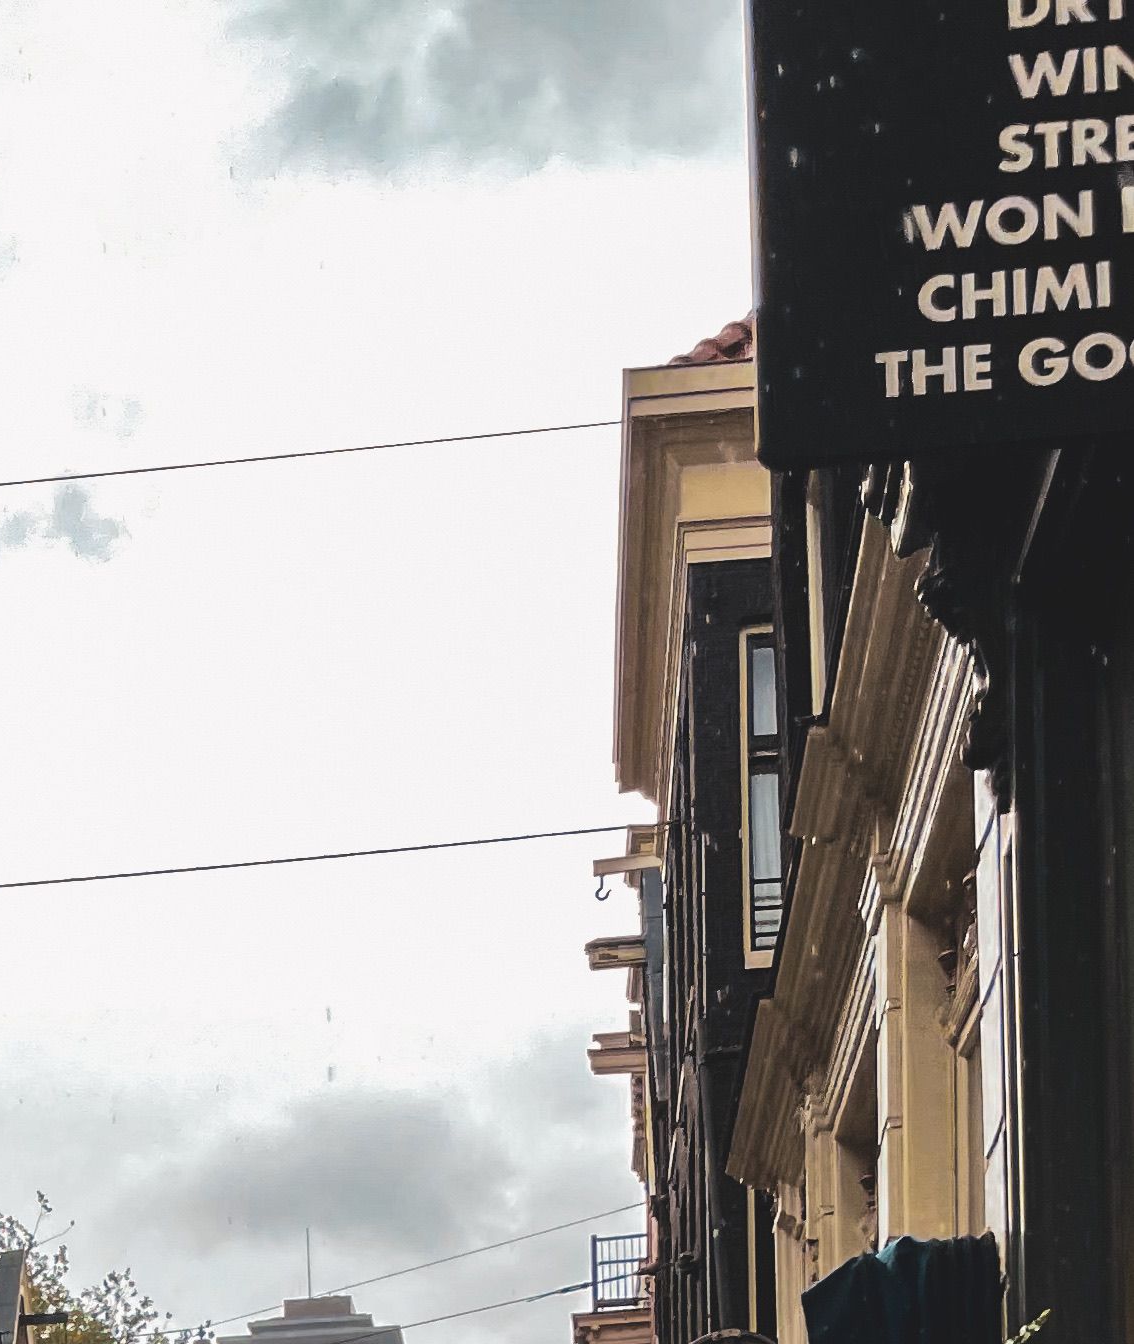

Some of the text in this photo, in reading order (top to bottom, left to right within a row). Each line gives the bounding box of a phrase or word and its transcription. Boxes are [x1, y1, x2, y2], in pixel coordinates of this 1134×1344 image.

[911, 189, 1094, 251] WON
[917, 260, 1111, 323] CHIMI
[874, 331, 1134, 398] THE GO
